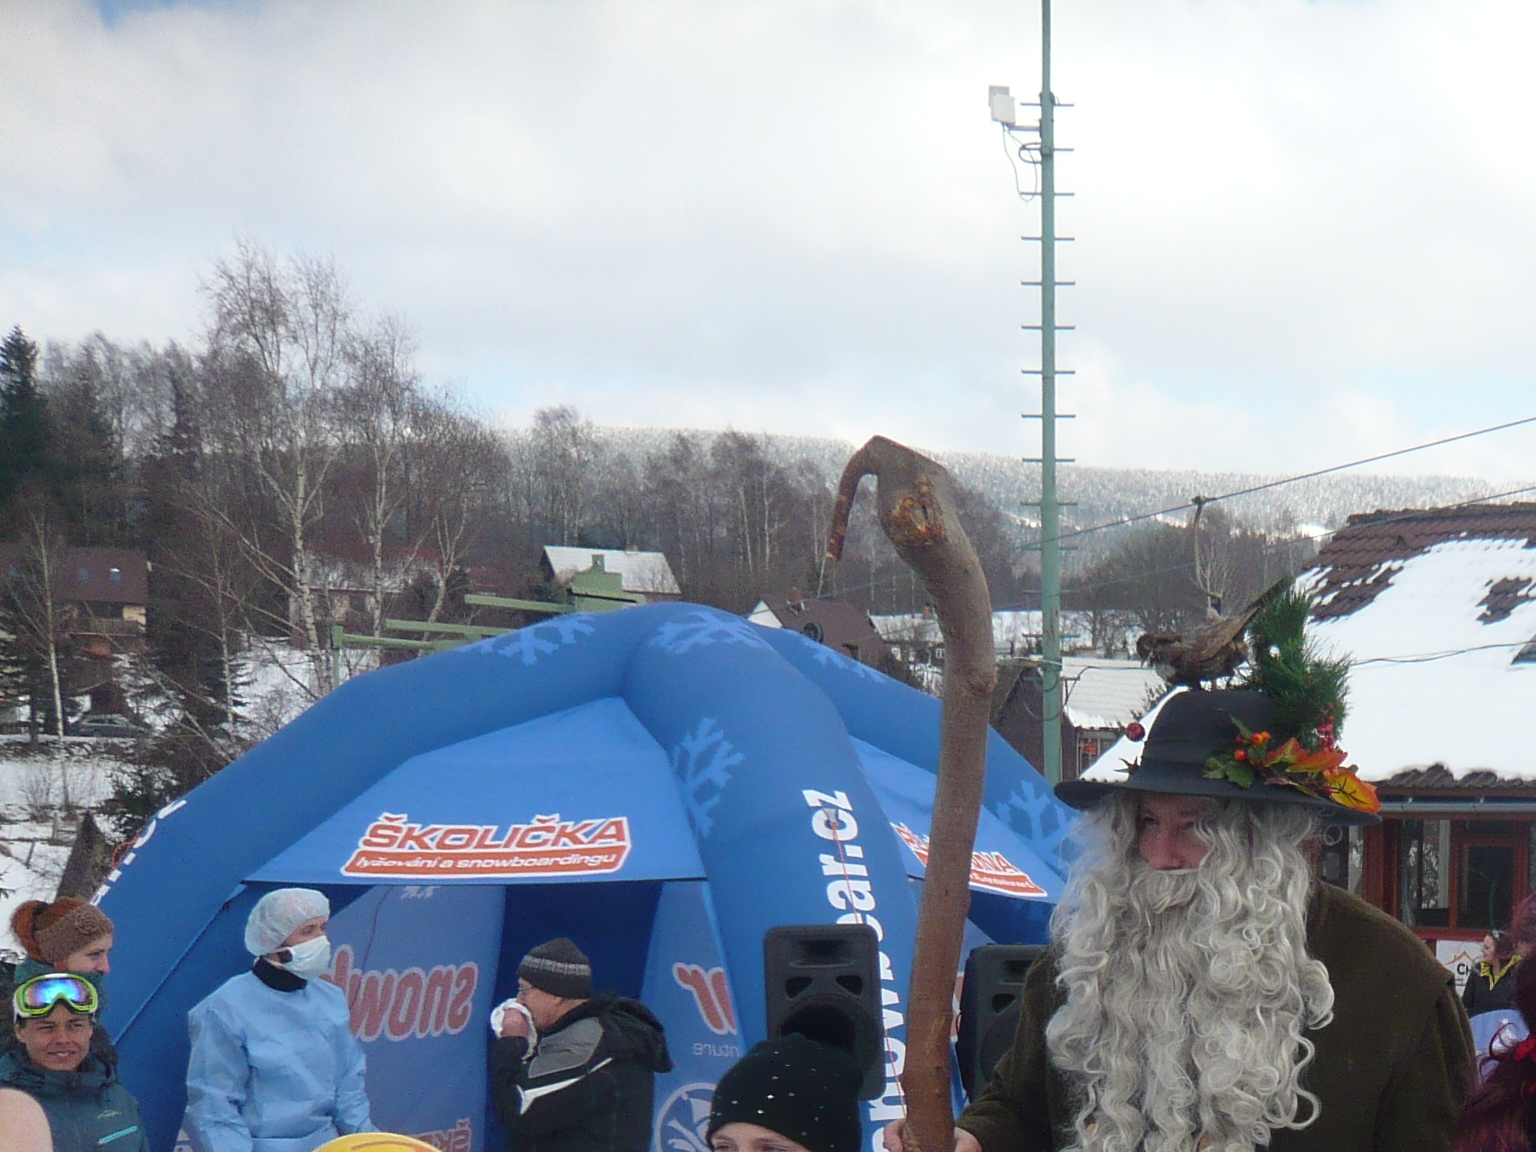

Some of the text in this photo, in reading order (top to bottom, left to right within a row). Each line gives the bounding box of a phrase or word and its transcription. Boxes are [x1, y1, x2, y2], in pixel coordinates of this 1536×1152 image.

[361, 812, 630, 851] ŠKOLIČKA
[439, 858, 454, 868] a
[456, 852, 617, 869] snowboardingu
